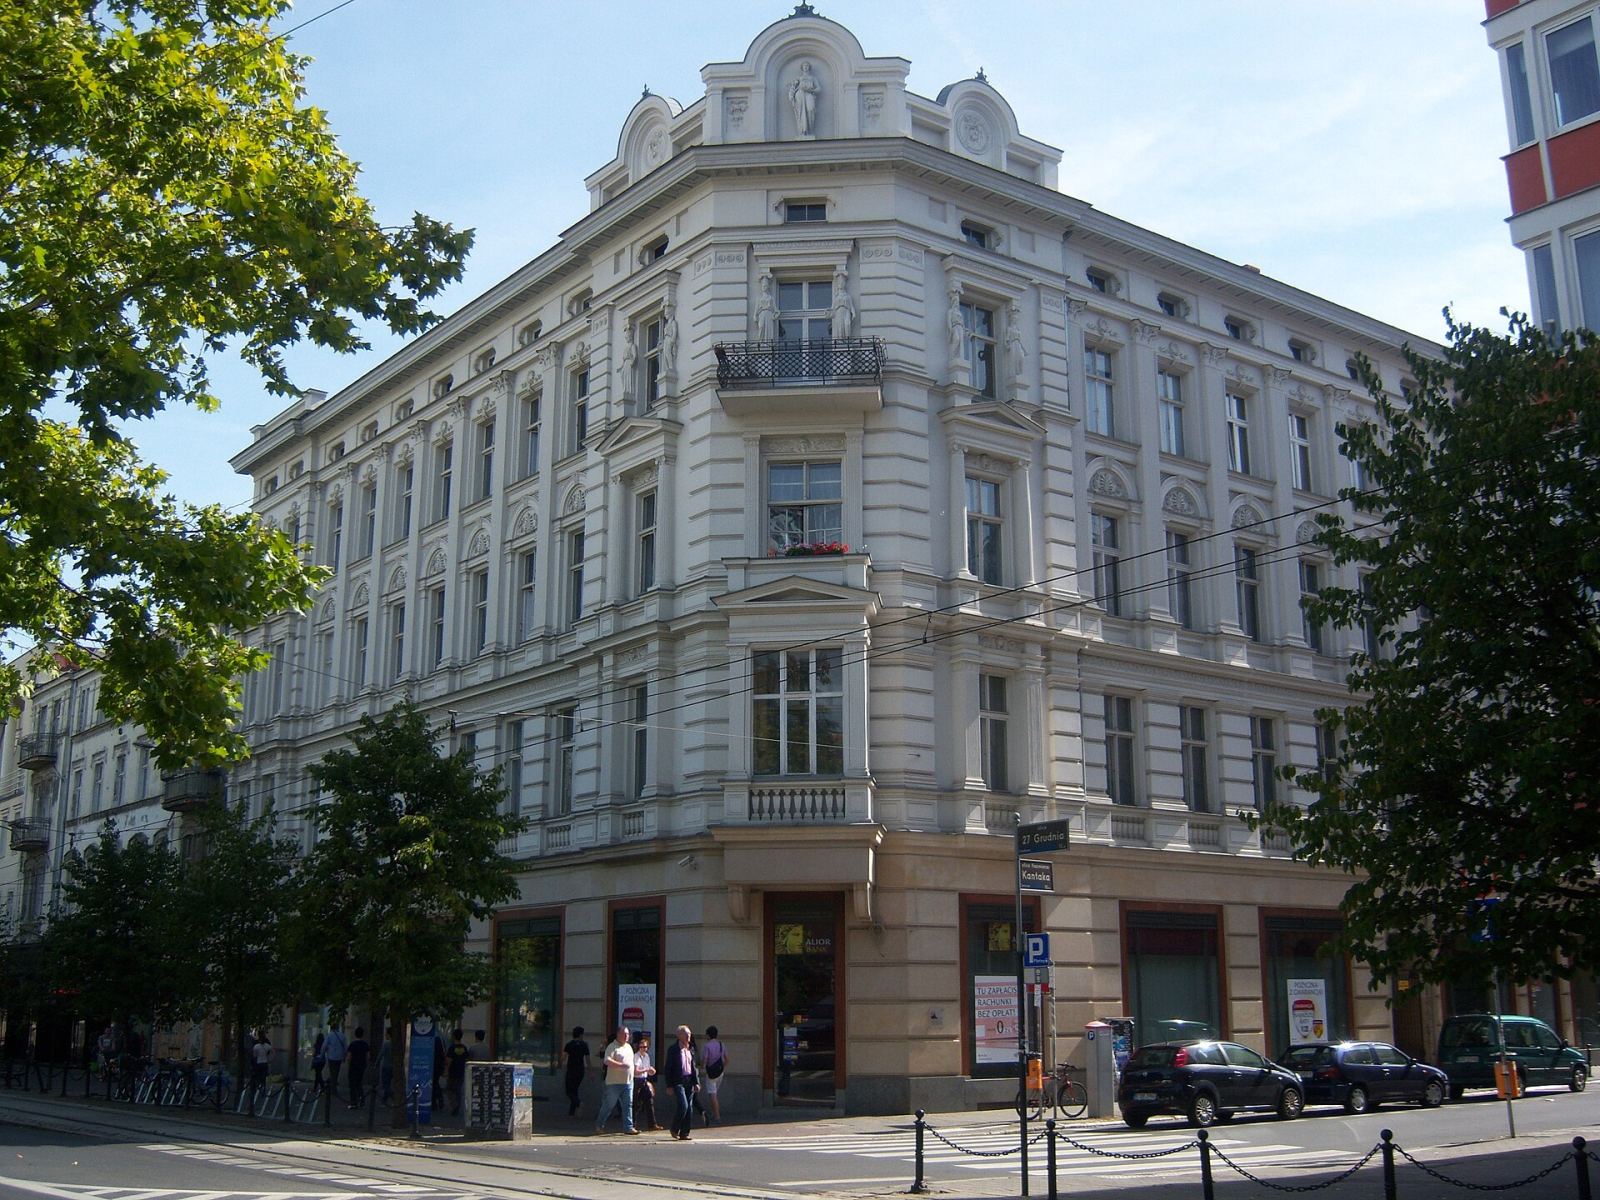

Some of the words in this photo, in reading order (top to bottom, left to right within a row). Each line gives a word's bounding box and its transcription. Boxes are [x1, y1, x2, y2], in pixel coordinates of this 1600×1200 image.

[1022, 834, 1031, 845] 27
[1033, 832, 1064, 843] Grudnia
[1022, 870, 1051, 881] Kantaka
[1028, 937, 1044, 964] P
[988, 986, 1017, 994] ZAPŁACIS
[977, 998, 1012, 1006] RACHUNKI
[977, 1010, 990, 1018] BEZ
[996, 1020, 1004, 1034] 0
